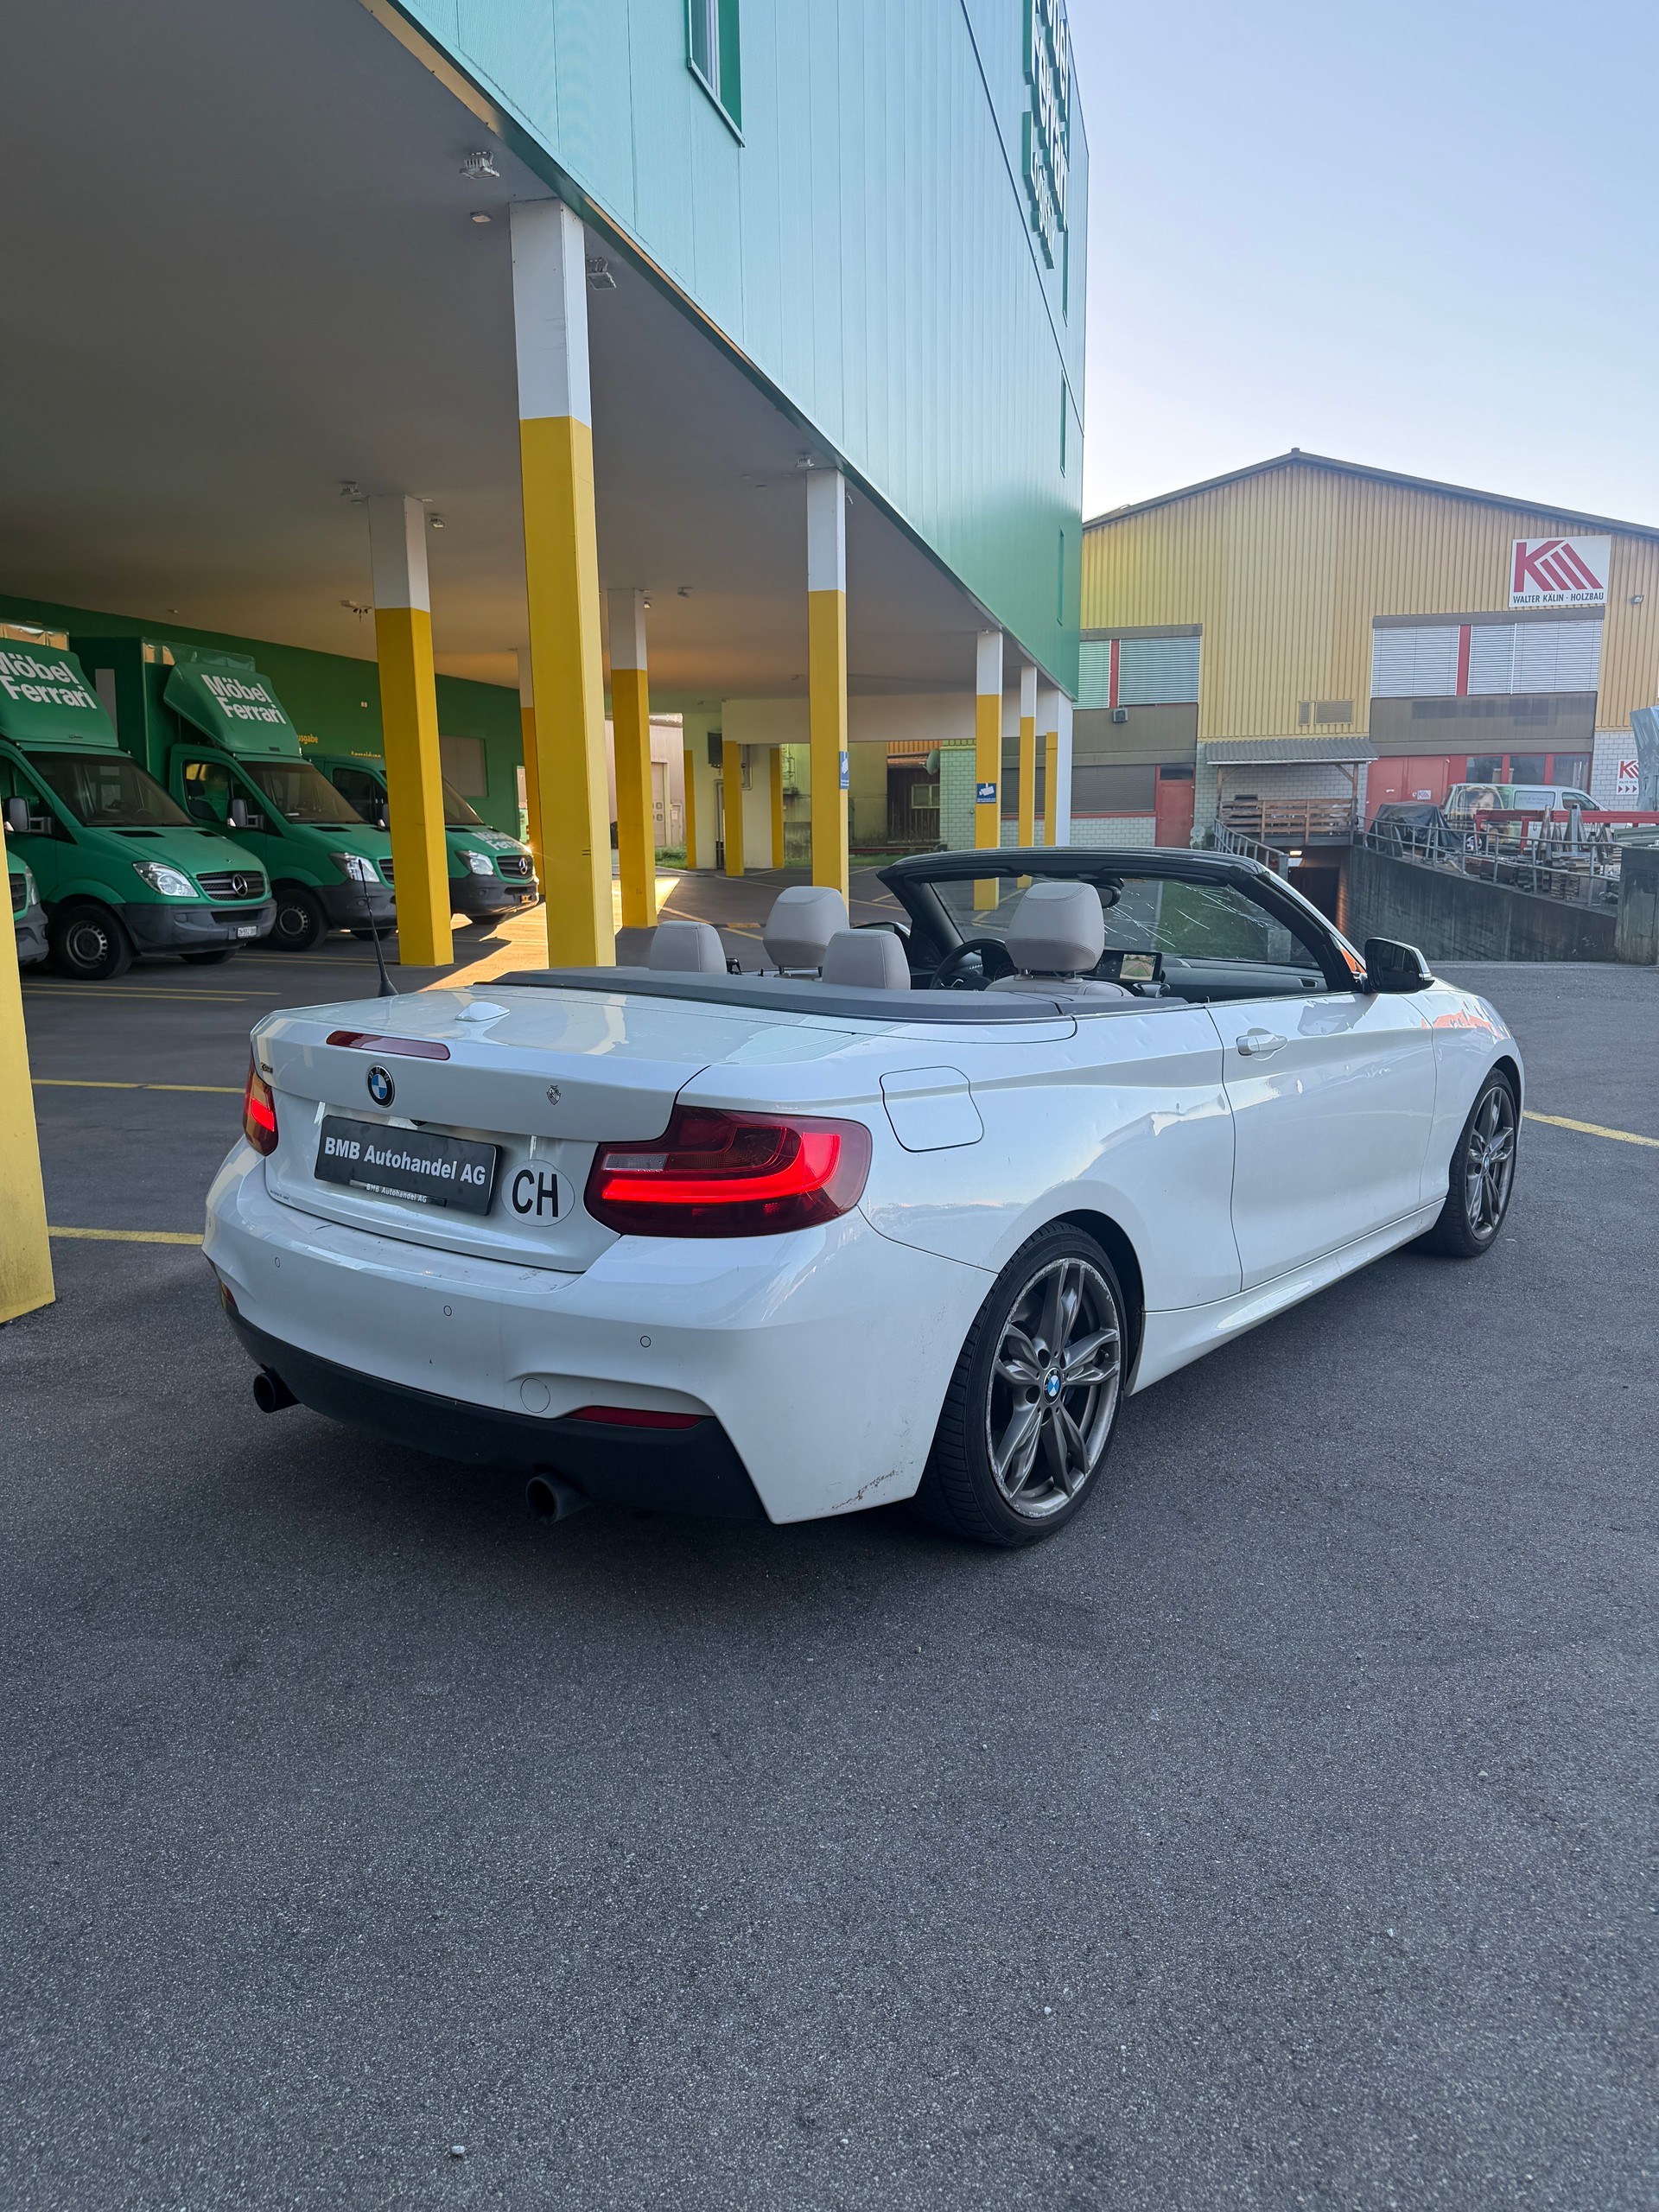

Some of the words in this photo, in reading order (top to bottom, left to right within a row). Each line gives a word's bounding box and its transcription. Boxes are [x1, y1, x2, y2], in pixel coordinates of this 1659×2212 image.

[1513, 594, 1541, 604] WALTER
[1542, 593, 1564, 602] KÄLIN
[1570, 592, 1605, 601] HOLZBAU
[0, 675, 98, 709] Ferrari
[200, 674, 273, 703] Möbel
[216, 696, 287, 725] Ferrari
[297, 734, 319, 745] usgabe
[324, 1136, 360, 1160] BMB
[364, 1145, 458, 1180] Autohandel
[460, 1163, 486, 1185] AG
[366, 1183, 380, 1192] BMB
[381, 1186, 417, 1201] Autohandel
[417, 1193, 428, 1204] AG
[512, 1169, 559, 1218] CH
